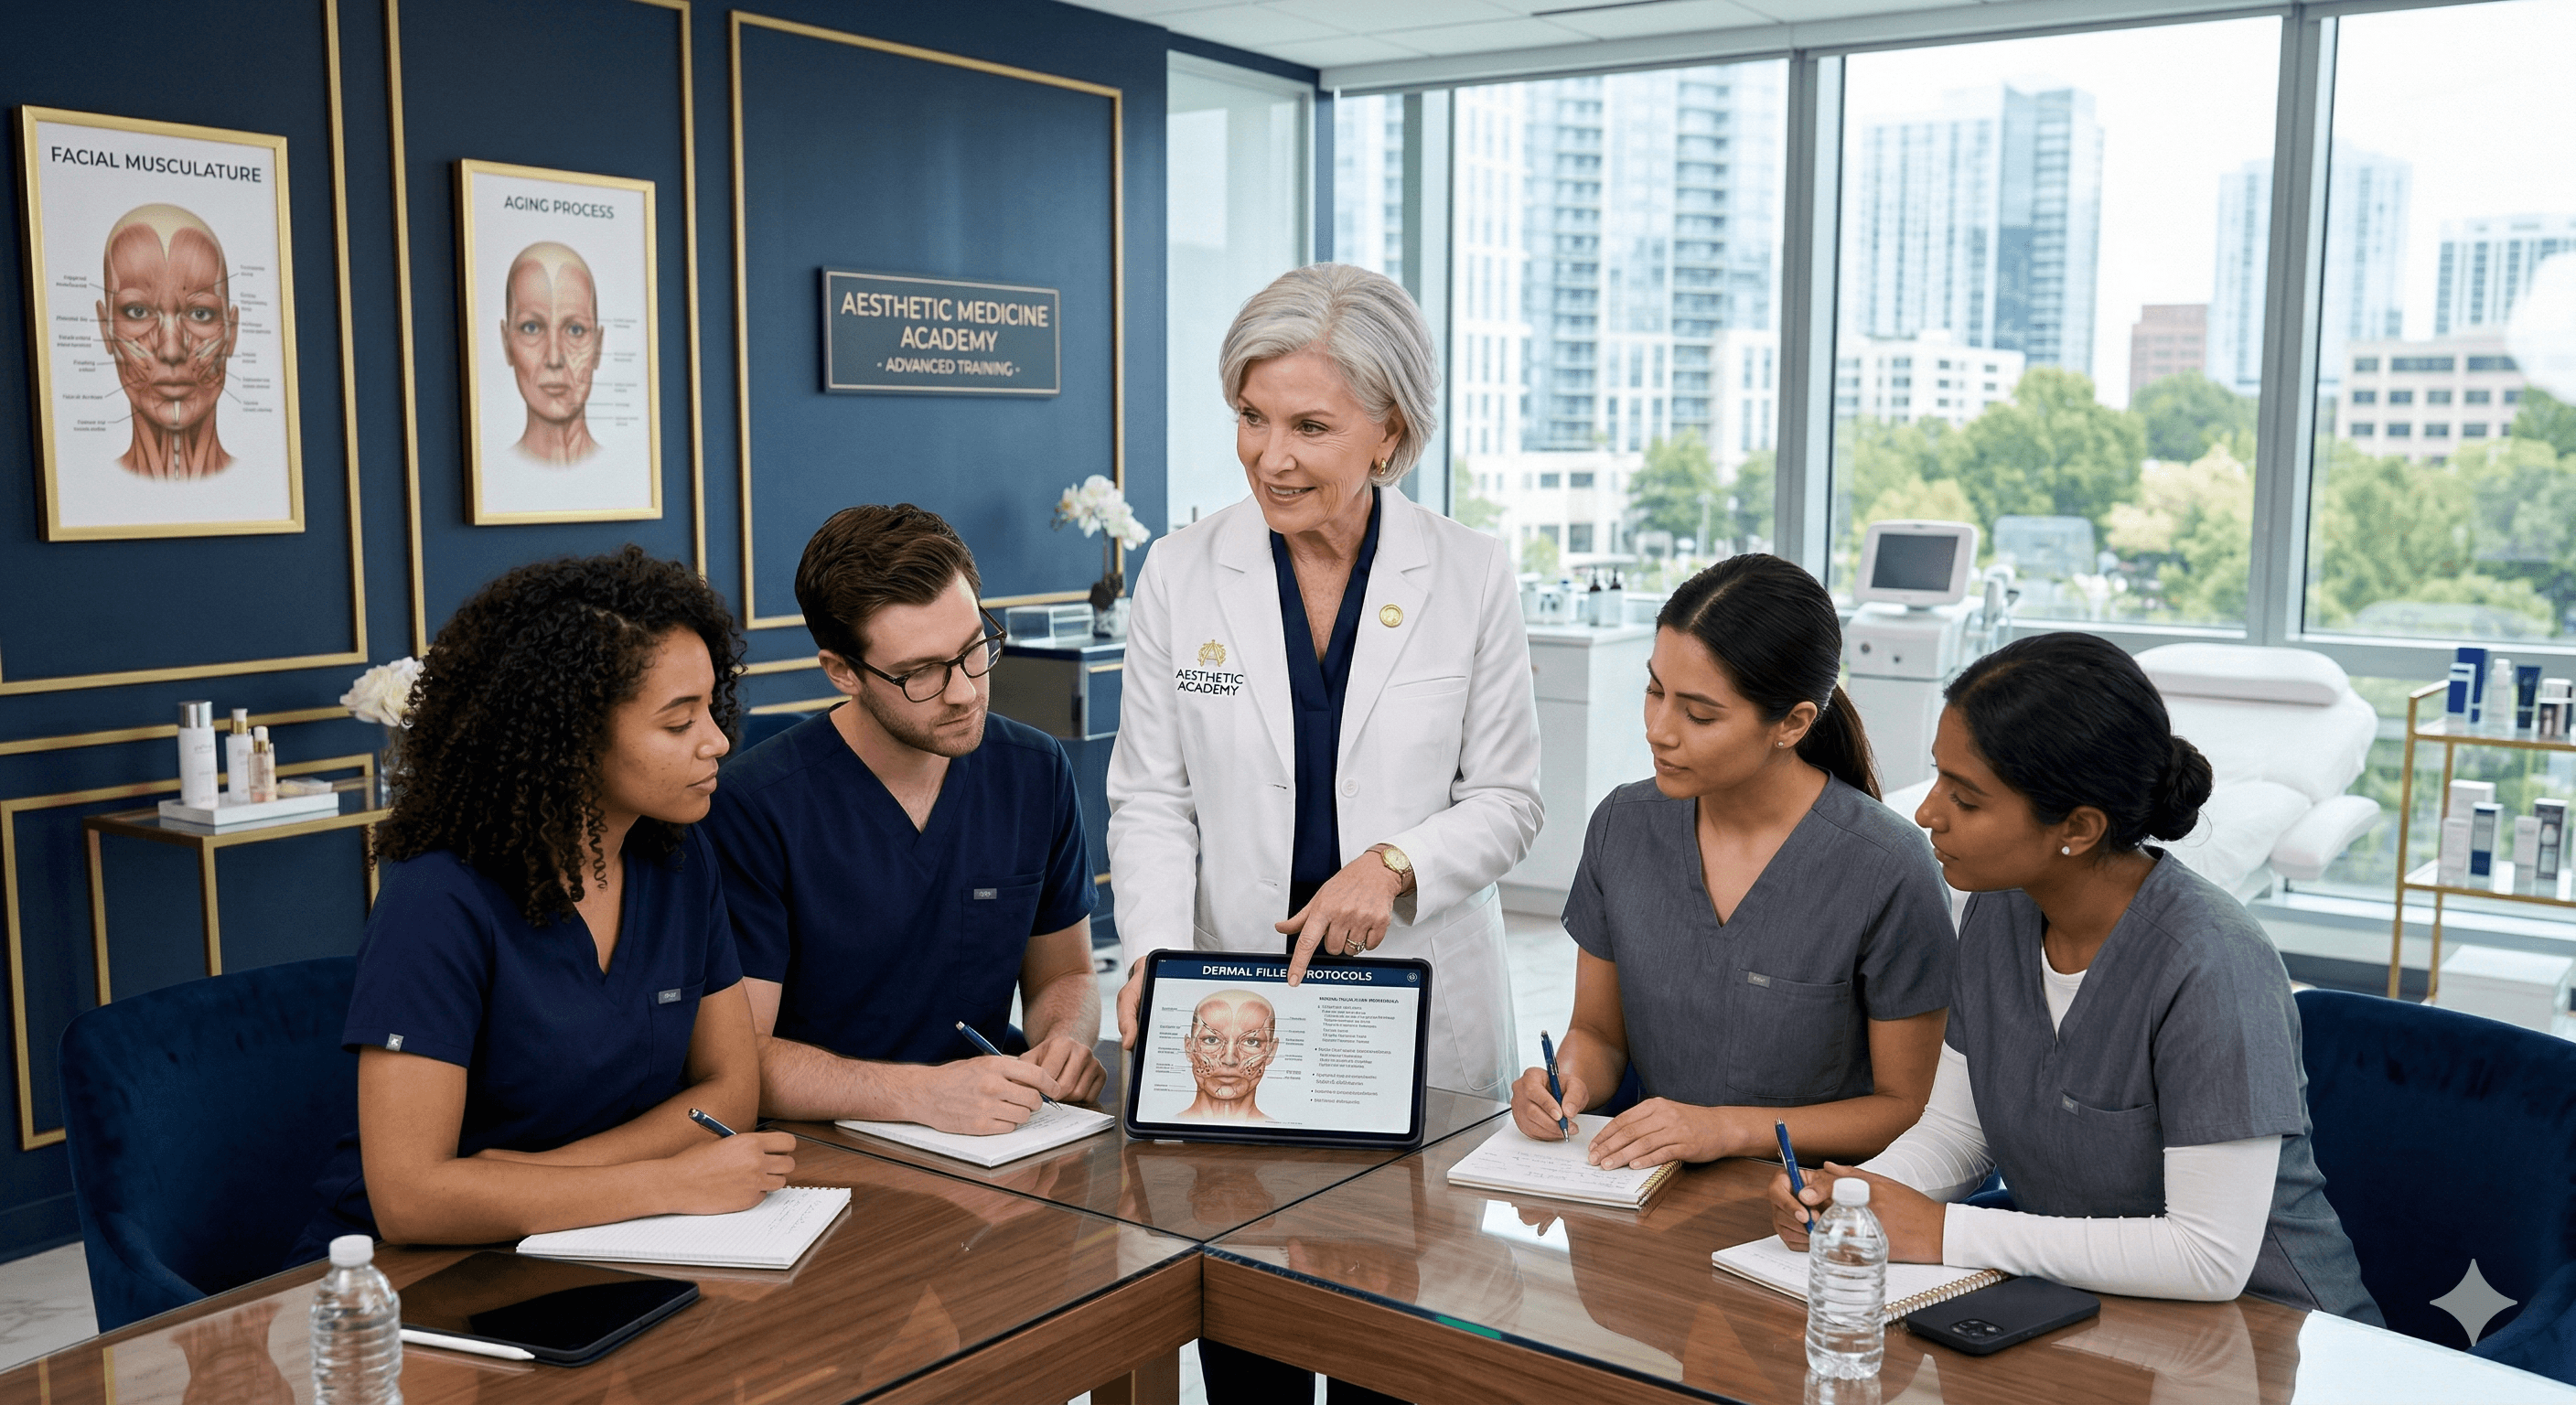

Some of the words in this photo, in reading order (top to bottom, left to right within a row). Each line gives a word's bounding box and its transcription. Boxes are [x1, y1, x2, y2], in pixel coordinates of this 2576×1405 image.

[51, 145, 120, 168] FACIAL
[125, 154, 263, 183] MUSCULATURE
[504, 195, 550, 212] AGING
[553, 199, 615, 220] PROCESS
[841, 291, 953, 321] AESTHETIC
[957, 299, 1049, 327] MEDICINE
[900, 326, 999, 353] ACADEMY
[885, 357, 955, 374] ADVANCED
[957, 359, 1014, 377] TRAINING
[1175, 669, 1244, 684] AESTHETIC
[1177, 681, 1240, 696] ACADEMY
[1202, 965, 1252, 977] DERMAL
[1256, 967, 1287, 978] FILLE
[1306, 970, 1372, 981] ROTOCOLS
